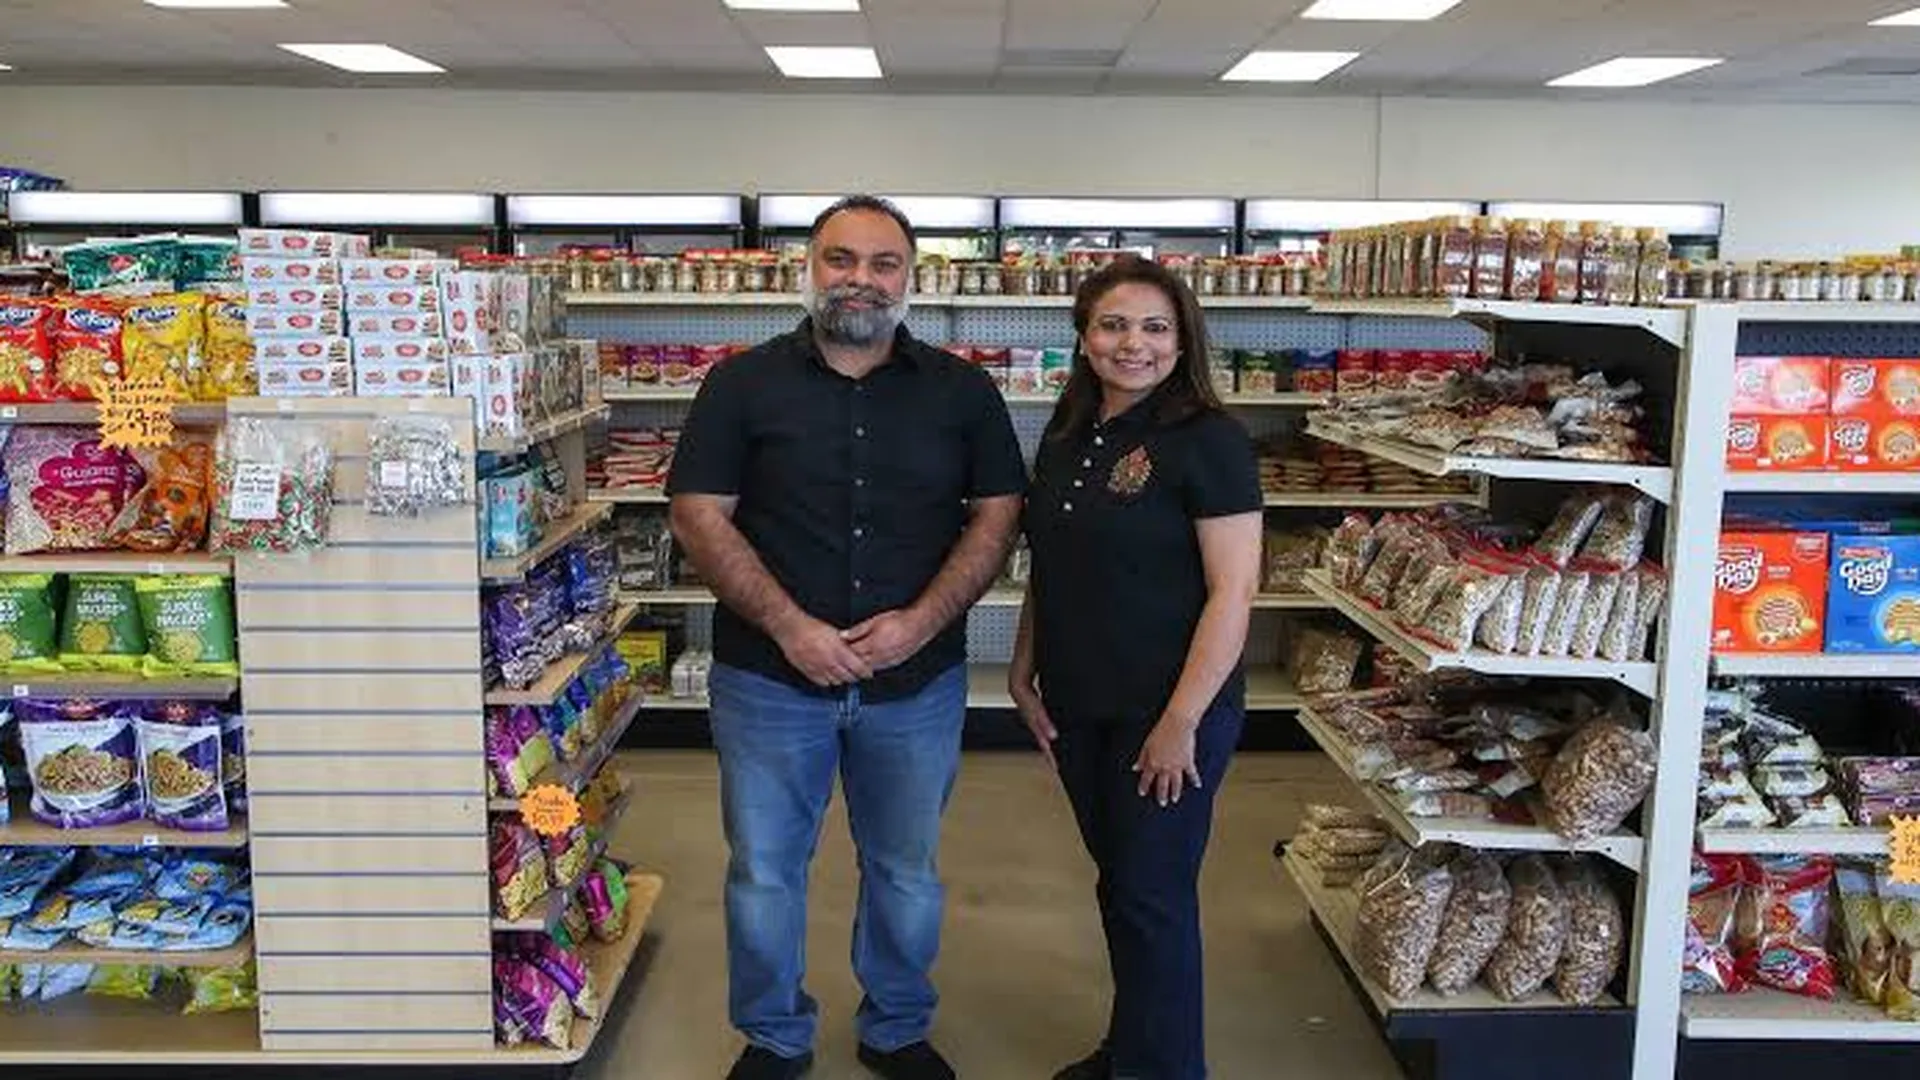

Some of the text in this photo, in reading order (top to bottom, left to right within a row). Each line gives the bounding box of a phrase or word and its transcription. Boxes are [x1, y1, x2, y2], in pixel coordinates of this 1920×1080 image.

[1713, 552, 1763, 577] Good
[1839, 552, 1892, 579] Good
[1718, 571, 1759, 595] Day
[1847, 571, 1888, 596] Day
